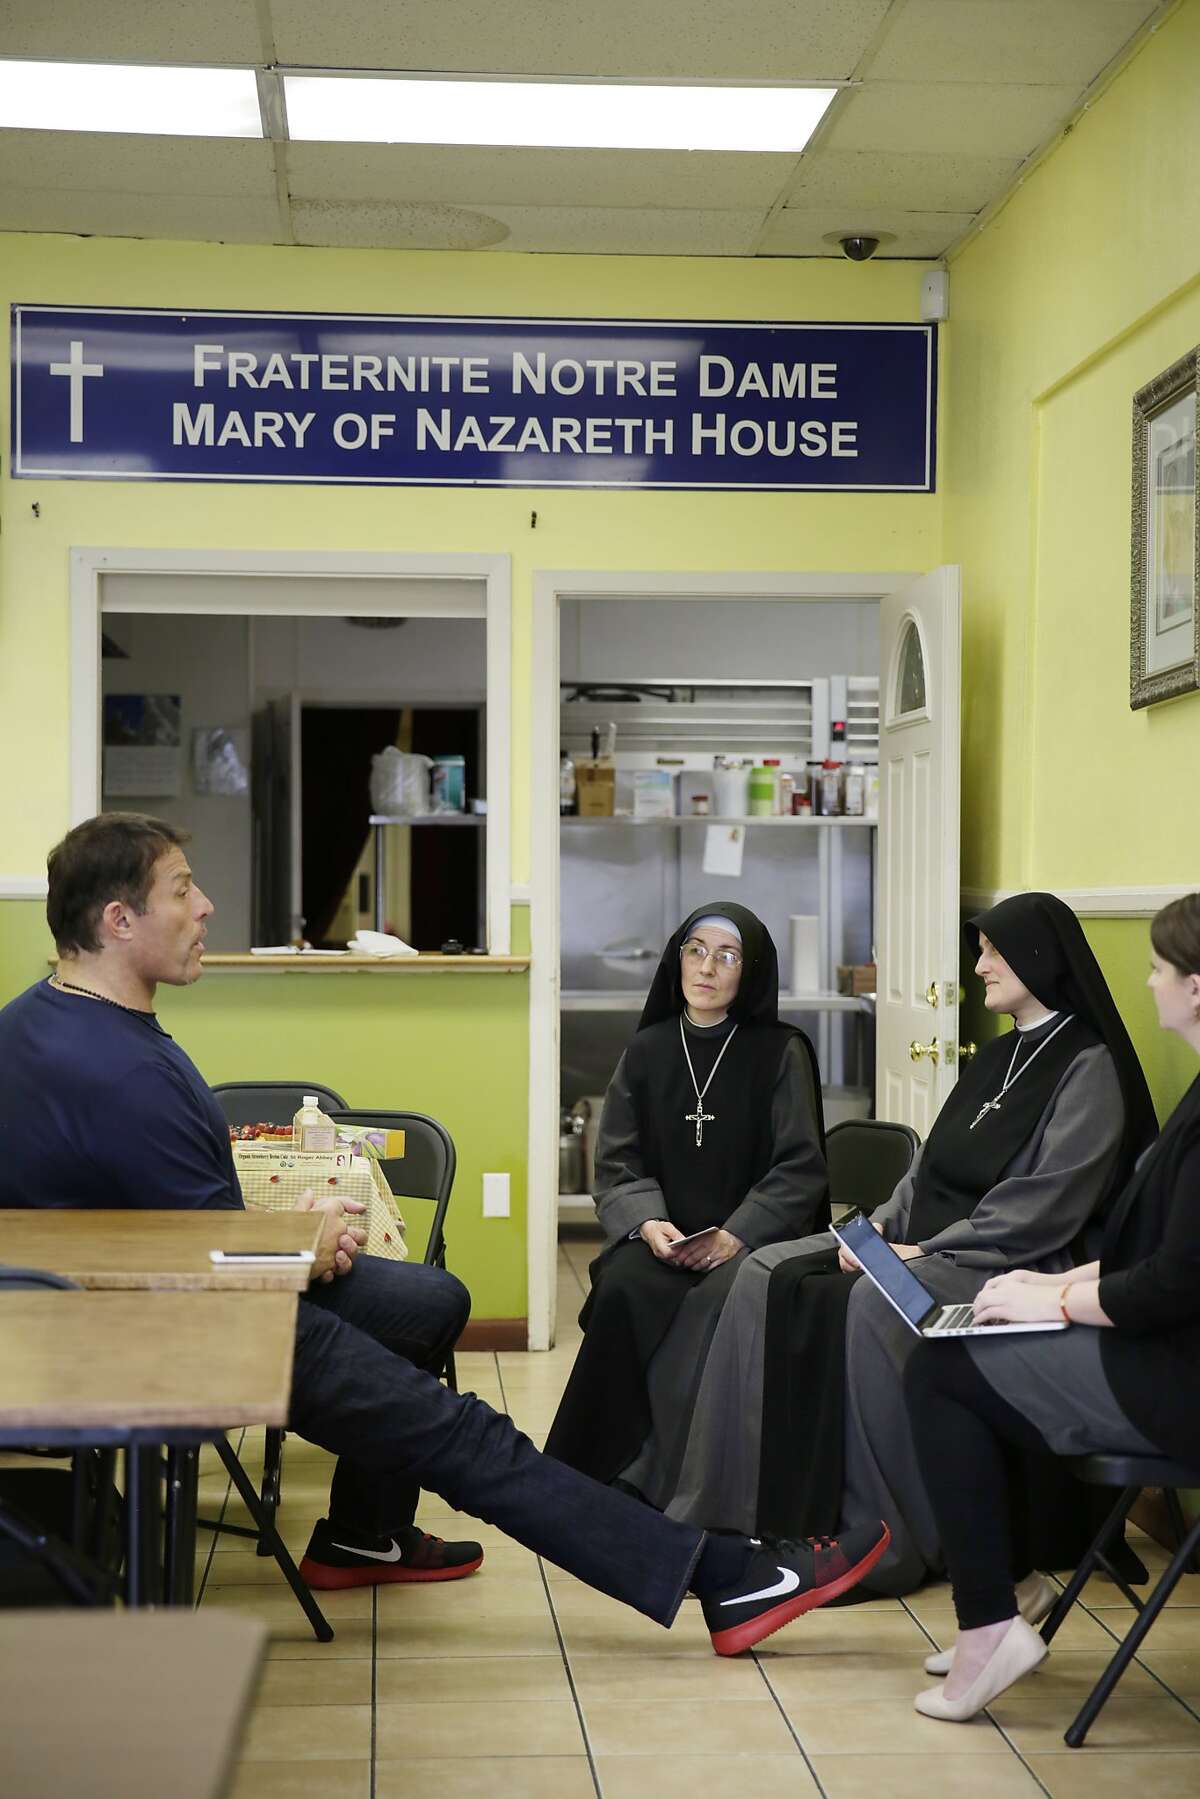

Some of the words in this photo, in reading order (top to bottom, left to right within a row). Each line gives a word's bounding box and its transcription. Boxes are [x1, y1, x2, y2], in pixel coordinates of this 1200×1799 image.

[194, 344, 490, 394] FRATERNITE
[512, 351, 678, 398] NOTRE
[699, 355, 838, 400] DAME
[172, 403, 316, 449] MARY
[333, 413, 396, 452] OF
[416, 408, 674, 456] NAZARETH
[691, 413, 859, 459] HOUSE
